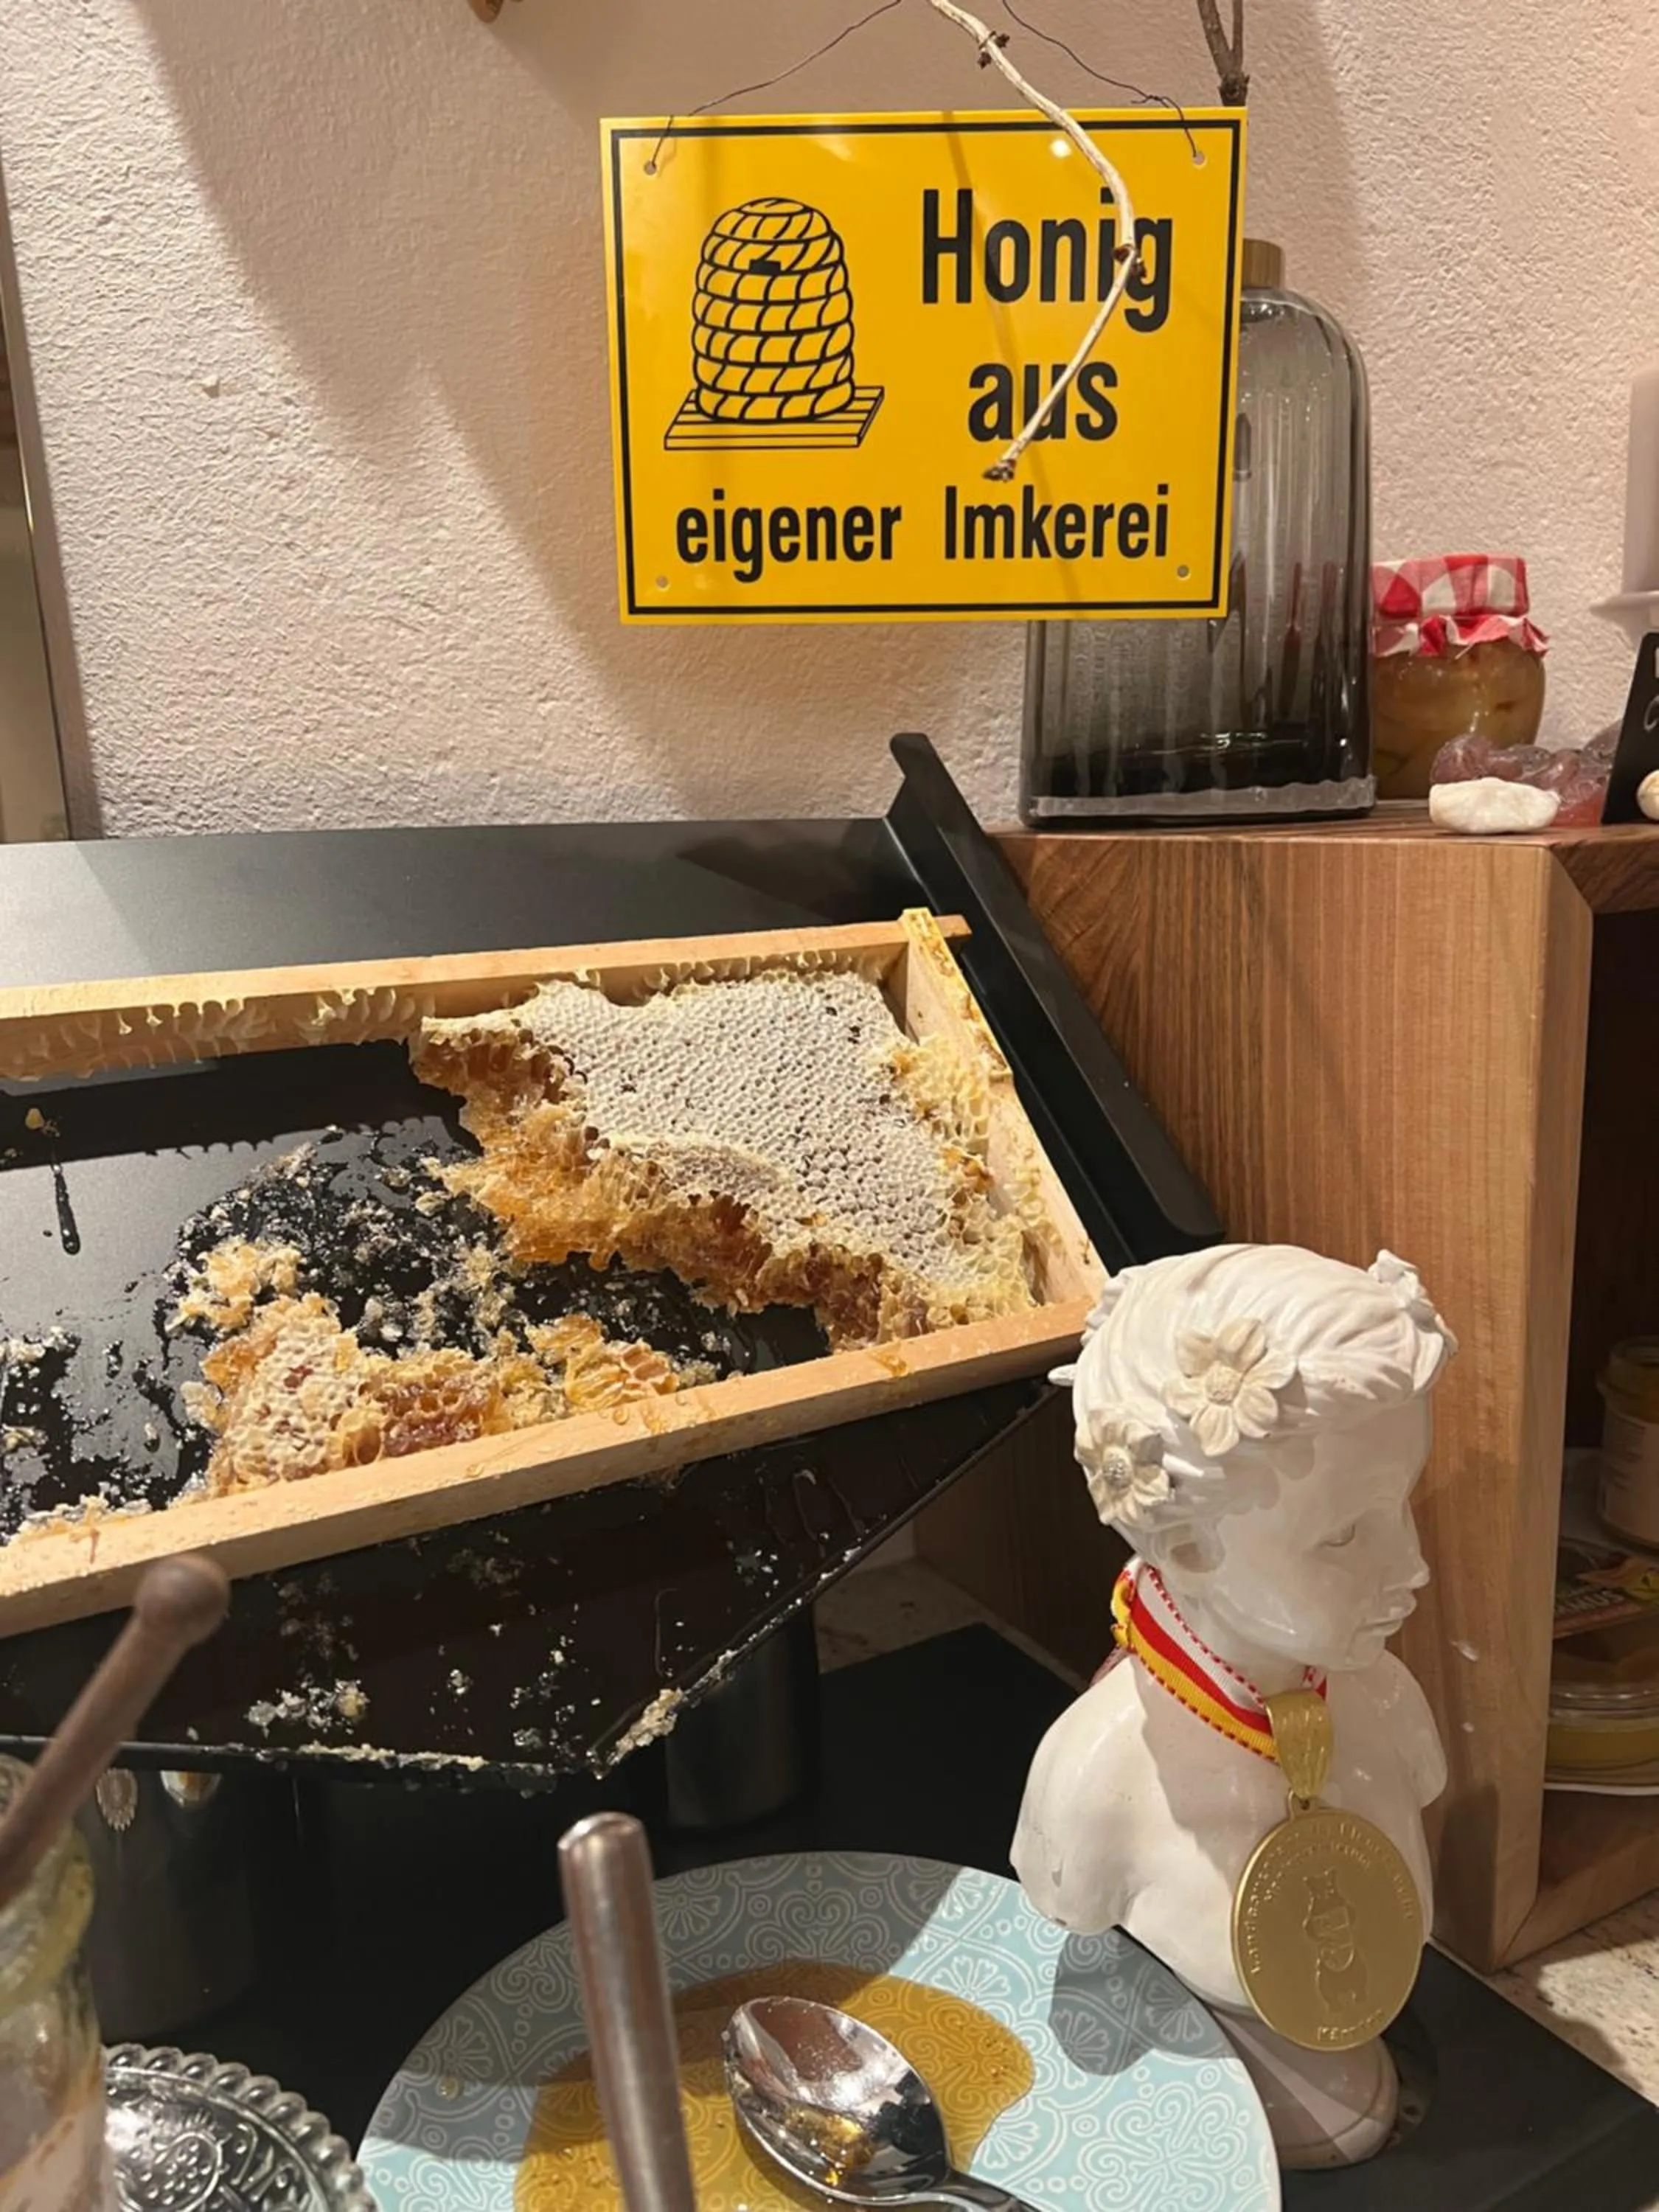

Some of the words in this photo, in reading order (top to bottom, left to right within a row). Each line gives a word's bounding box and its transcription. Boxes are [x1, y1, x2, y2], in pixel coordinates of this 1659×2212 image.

[922, 187, 1173, 333] Honig
[967, 361, 1119, 442] aus
[675, 488, 902, 583] eigener
[945, 483, 1169, 560] Imkerei
